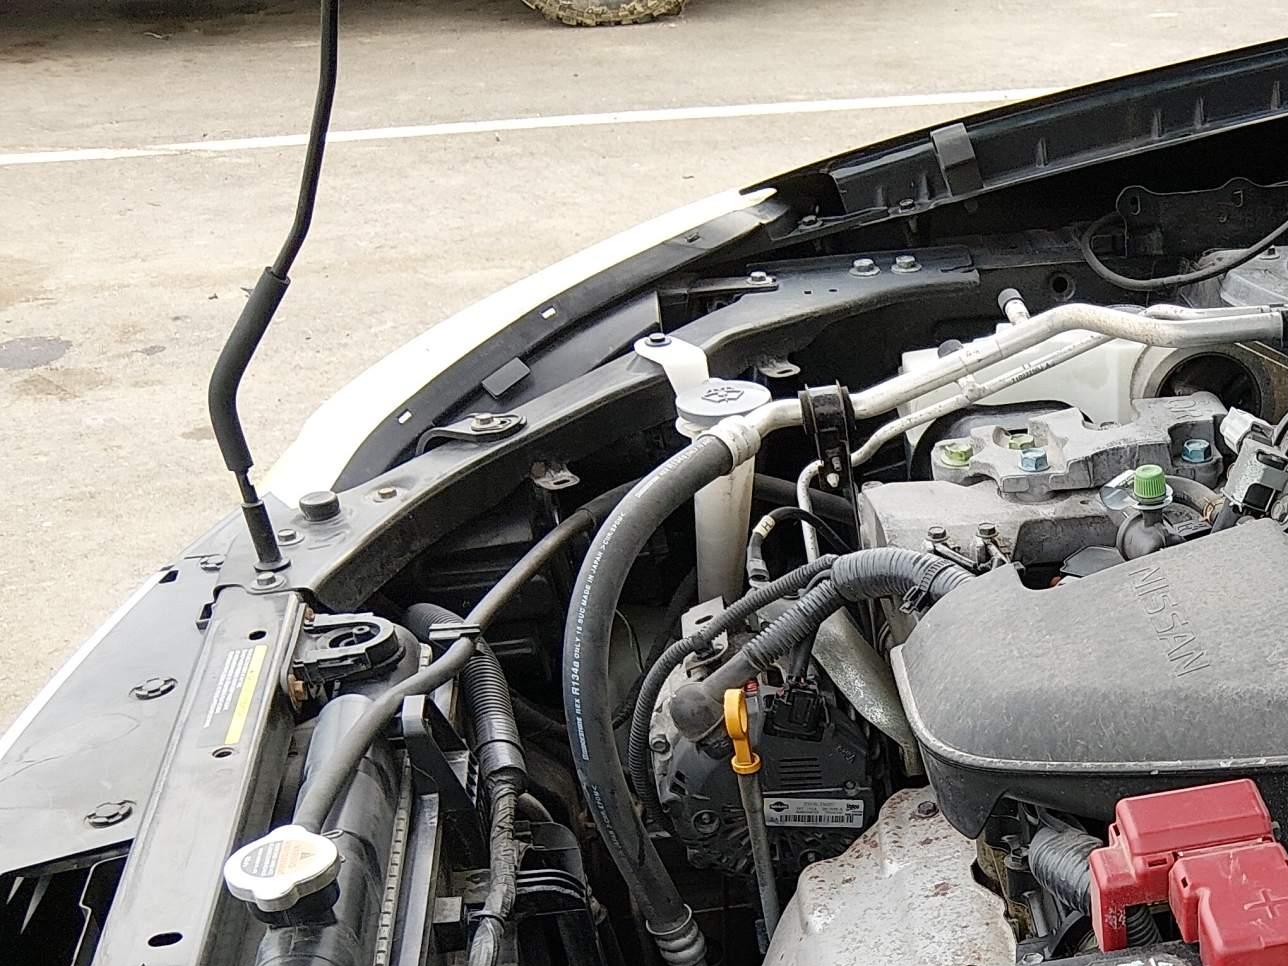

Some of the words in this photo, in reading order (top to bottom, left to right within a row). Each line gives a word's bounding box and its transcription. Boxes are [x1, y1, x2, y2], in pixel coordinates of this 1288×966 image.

[589, 550, 603, 573] JAPAN
[586, 573, 594, 583] IN
[580, 583, 591, 606] MADE
[1127, 566, 1212, 678] NISSAN
